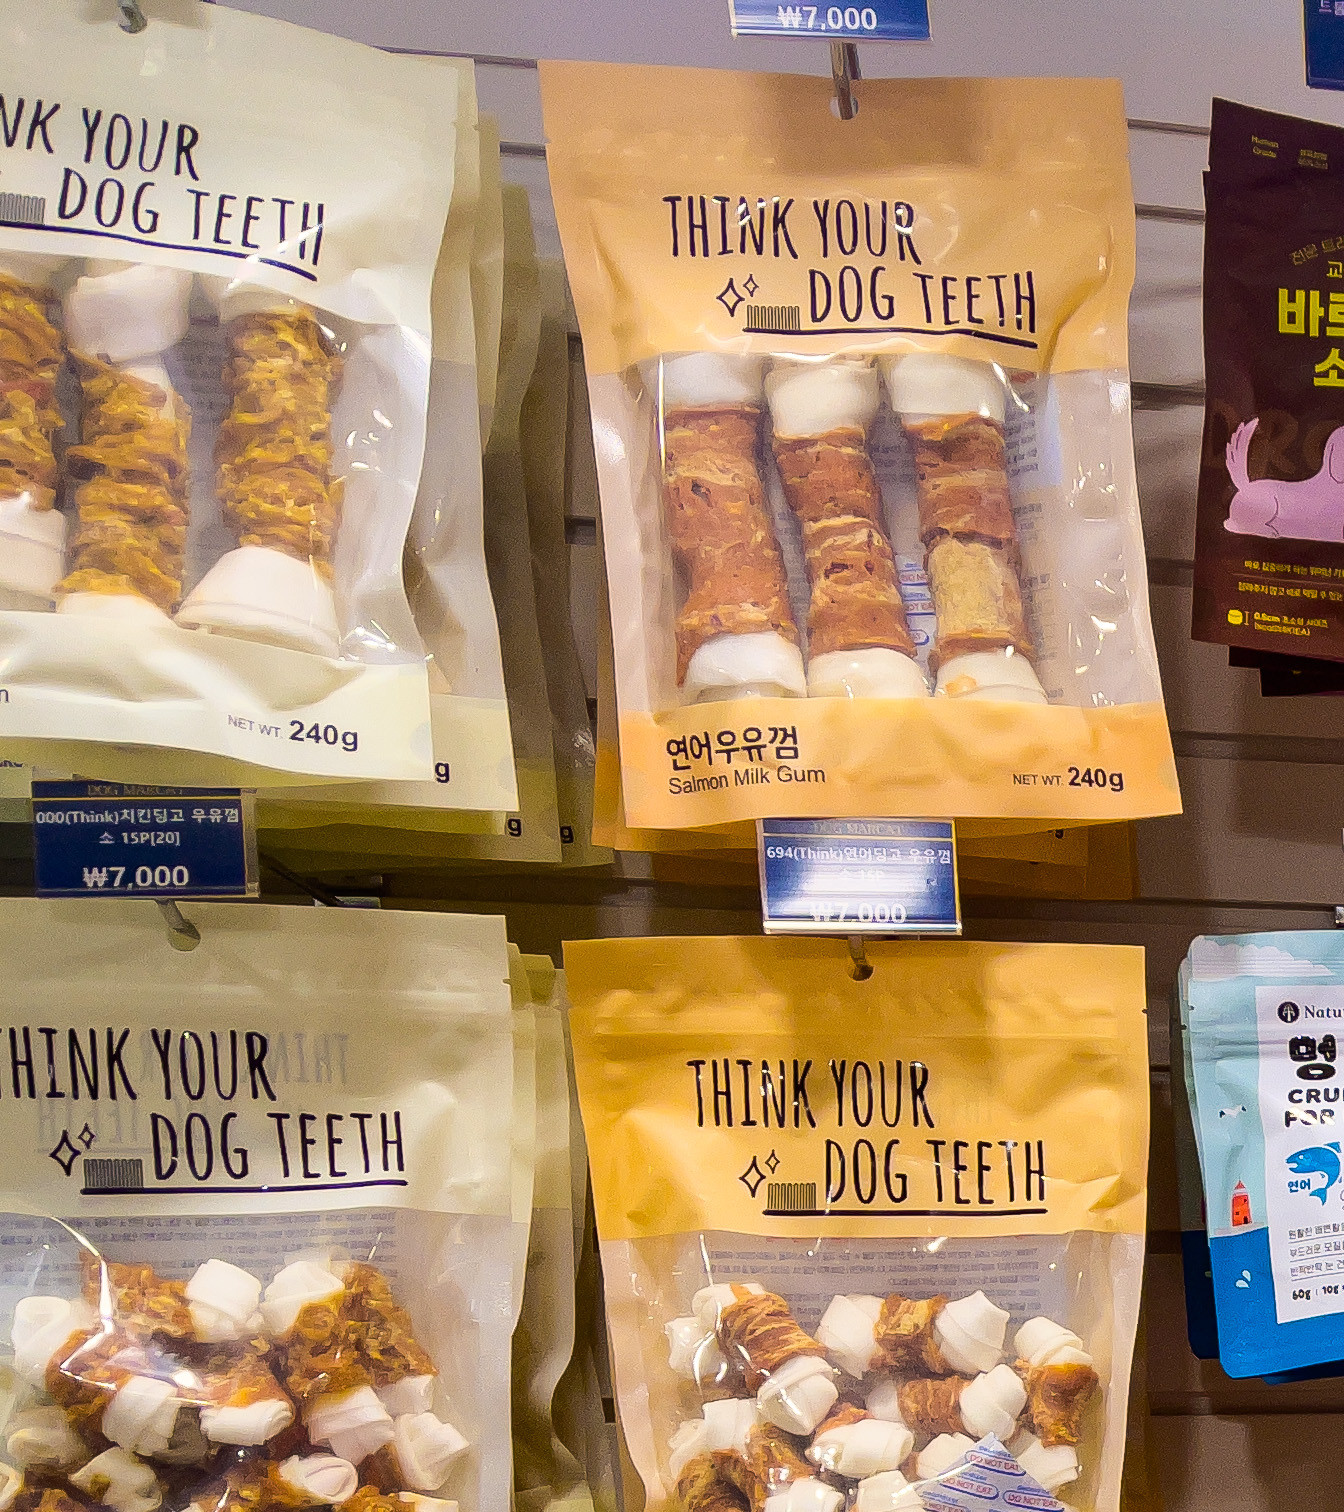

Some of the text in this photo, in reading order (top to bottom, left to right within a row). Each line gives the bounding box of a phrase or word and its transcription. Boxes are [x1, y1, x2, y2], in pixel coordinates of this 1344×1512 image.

[81, 108, 200, 180] YOUR
[58, 168, 325, 266] DOG TEETH
[663, 196, 921, 264] THINK YOUR
[808, 266, 1036, 332] DOG TEETH
[289, 720, 359, 752] 240g
[666, 727, 799, 772] 연어우유껌
[668, 765, 826, 794] Salmon Milk Gum
[152, 1029, 275, 1100] YOUR
[688, 1059, 934, 1129] THINK YOUR
[150, 1111, 405, 1180] DOG TEETH
[1285, 1107, 1335, 1127] FOR
[825, 1139, 1047, 1205] DOG TEETH
